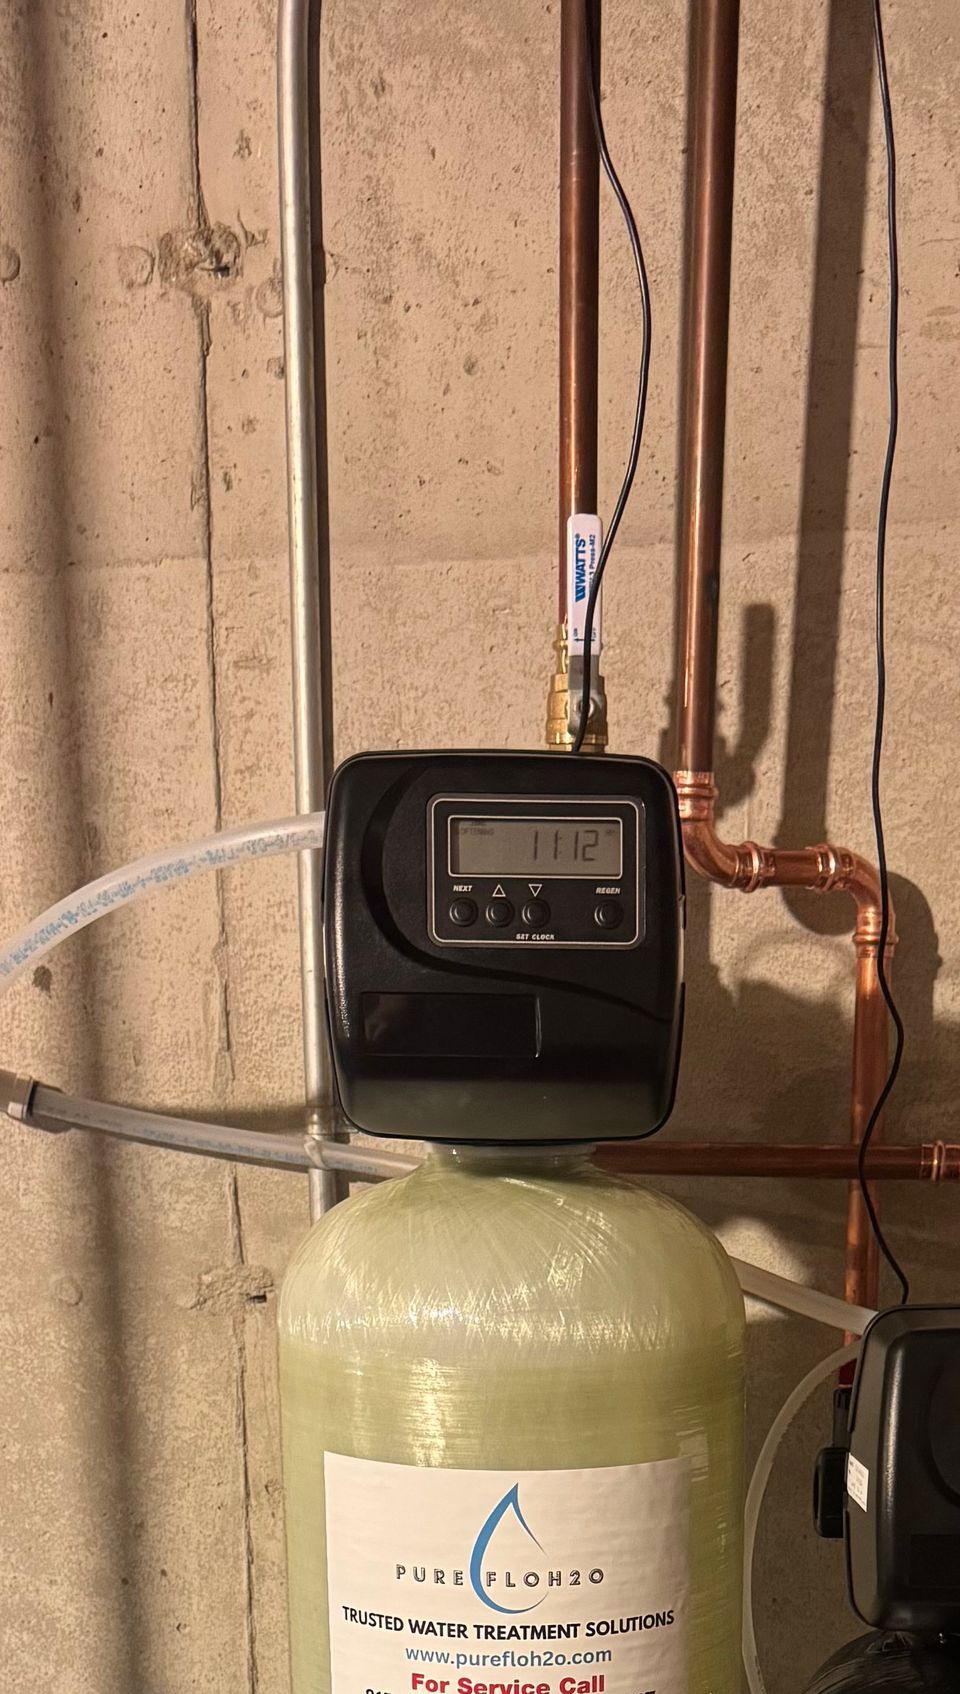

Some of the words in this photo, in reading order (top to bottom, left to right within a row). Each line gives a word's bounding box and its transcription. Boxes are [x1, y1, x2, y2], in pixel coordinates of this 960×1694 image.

[453, 884, 472, 892] NEXT
[596, 887, 621, 895] REGEN
[396, 1563, 464, 1586] PURE
[342, 1605, 404, 1632] TRUSTED
[408, 1618, 468, 1639] WATER
[474, 1622, 581, 1641] TREATMENT
[585, 1609, 675, 1637] SOLUTIONS
[405, 1647, 612, 1668] www.purefloh2o.com
[411, 1673, 450, 1694] For
[559, 1674, 605, 1694] Call
